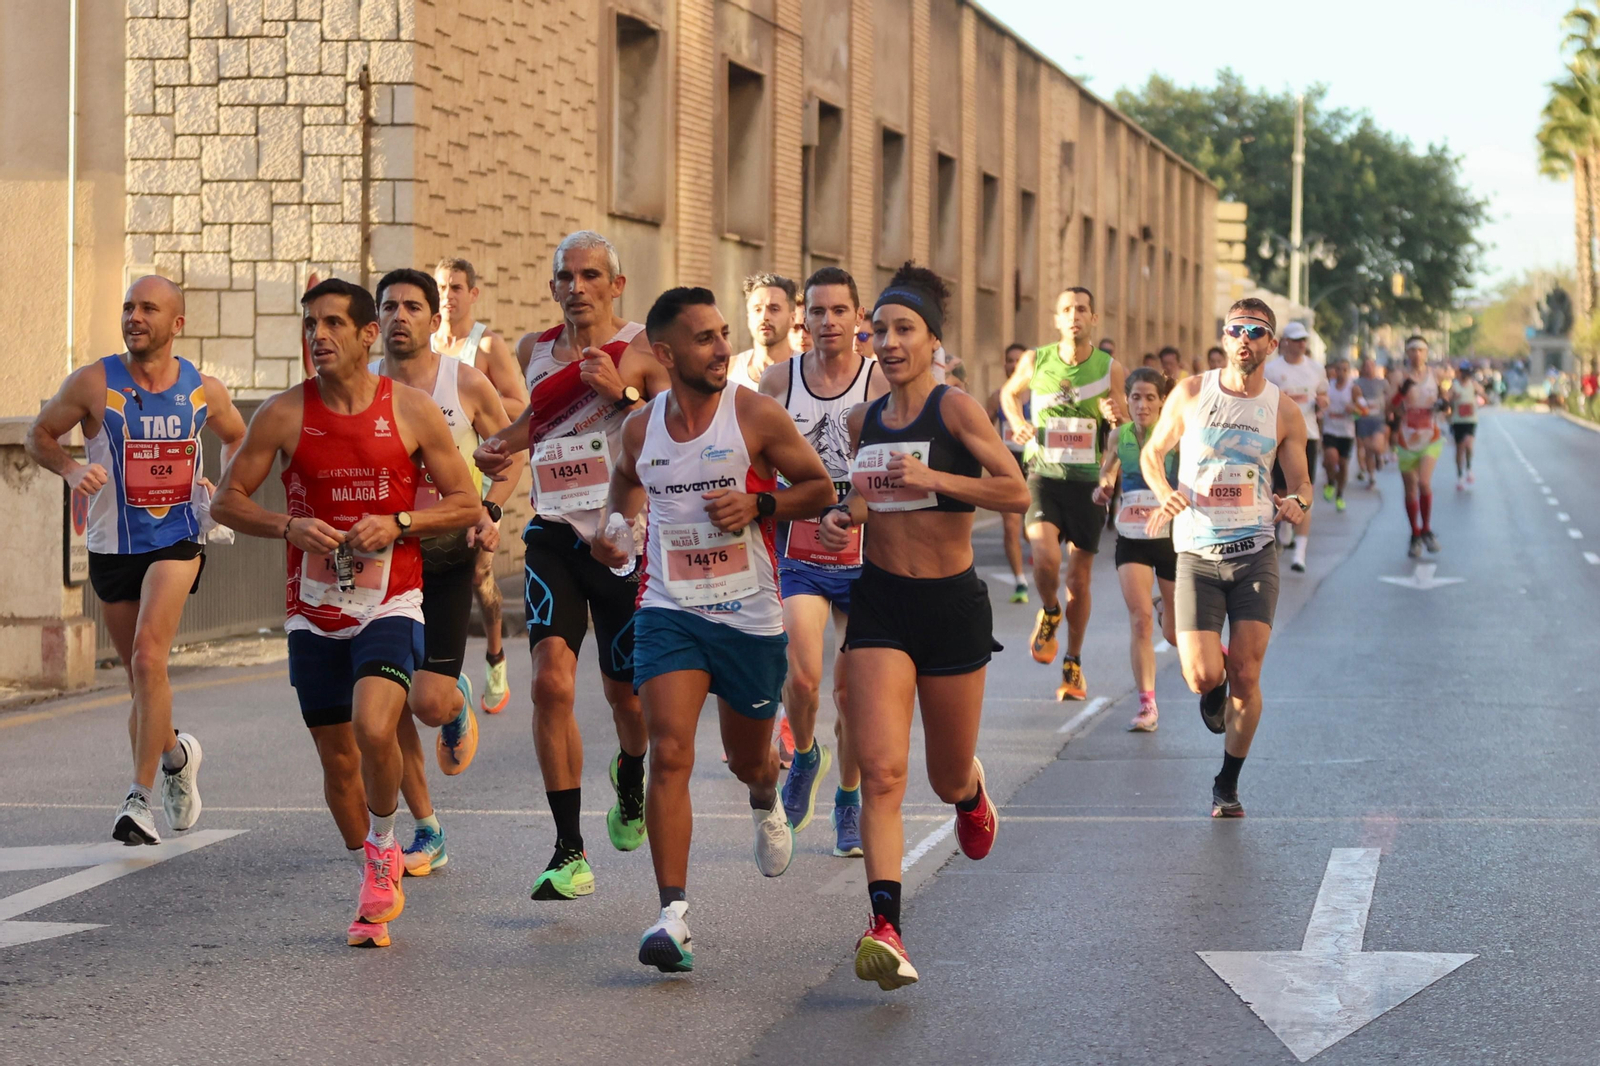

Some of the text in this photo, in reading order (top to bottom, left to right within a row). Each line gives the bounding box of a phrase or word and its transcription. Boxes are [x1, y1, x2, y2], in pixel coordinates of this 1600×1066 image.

[140, 415, 181, 439] TAC
[1210, 421, 1260, 434] ARGENTINA
[150, 465, 173, 475] 624
[330, 468, 375, 477] GENERALI
[550, 463, 589, 479] 14341
[332, 485, 377, 501] MÁLAGA
[1210, 488, 1242, 498] 10258
[707, 531, 724, 539] 21K
[685, 550, 728, 566] 14476
